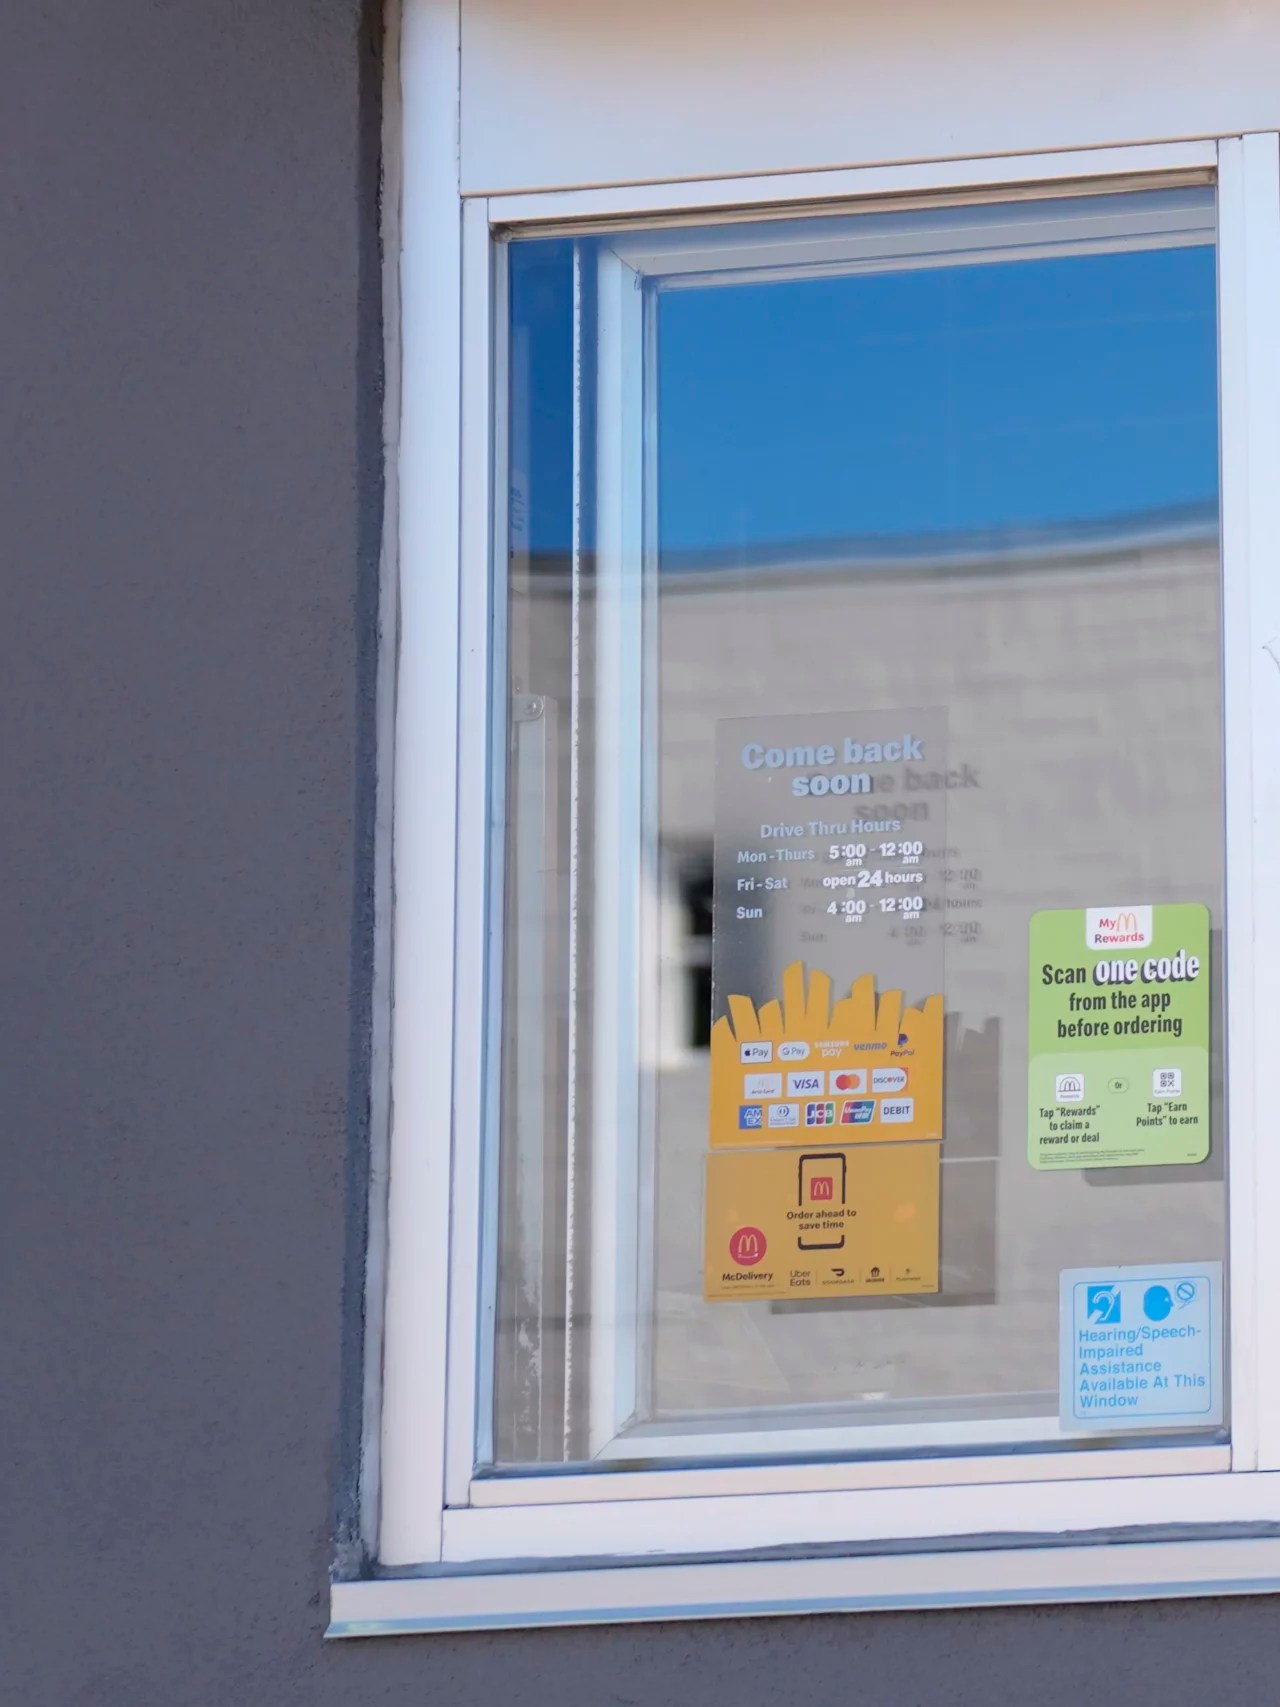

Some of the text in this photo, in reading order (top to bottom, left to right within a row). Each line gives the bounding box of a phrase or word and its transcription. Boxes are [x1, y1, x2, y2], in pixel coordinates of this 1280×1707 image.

[741, 734, 923, 770] Come back
[792, 772, 871, 796] soon
[761, 819, 901, 838] Drive Thru Hours
[829, 843, 866, 859] 5:00
[879, 841, 923, 857] 12:00
[845, 857, 862, 866] am
[902, 855, 919, 865] am
[823, 876, 856, 889] open
[857, 870, 883, 888] 24
[884, 871, 923, 884] hours
[827, 900, 866, 915] 4:00
[879, 896, 923, 913] 12:00
[736, 906, 763, 920] Sun
[845, 914, 862, 923] am
[903, 910, 920, 920] am
[1099, 918, 1116, 930] My
[1095, 932, 1144, 944] Rewards
[1042, 949, 1199, 985] Scan one code
[1070, 990, 1171, 1012] from the app
[1058, 1015, 1182, 1038] before ordering
[854, 1042, 887, 1051] venmo
[752, 1048, 769, 1058] Pay
[821, 1048, 842, 1058] pay
[890, 1049, 915, 1057] PayPal
[793, 1079, 819, 1089] VISA
[873, 1076, 905, 1084] DISCOVER
[745, 1108, 762, 1117] AM
[808, 1109, 833, 1118] JCB
[883, 1106, 910, 1115] DEBIT
[1040, 1108, 1054, 1119] Tap
[1147, 1103, 1162, 1114] Tap
[747, 1117, 762, 1126] EX
[1050, 1121, 1058, 1131] to
[1060, 1119, 1083, 1130] claim
[1169, 1116, 1178, 1125] to
[1179, 1116, 1198, 1125] earn
[1040, 1132, 1100, 1145] reward or deal
[786, 1209, 857, 1220] Order ahead to
[799, 1220, 844, 1230] save time
[722, 1271, 773, 1281] McDelivery
[790, 1270, 811, 1278] Uber
[790, 1278, 811, 1286] Eats
[1079, 1325, 1201, 1343] Hearing/Speech-
[1079, 1343, 1143, 1361] Impaired
[1080, 1360, 1162, 1375] Assistance
[1080, 1373, 1206, 1392] Available At This
[1080, 1394, 1139, 1409] Window
